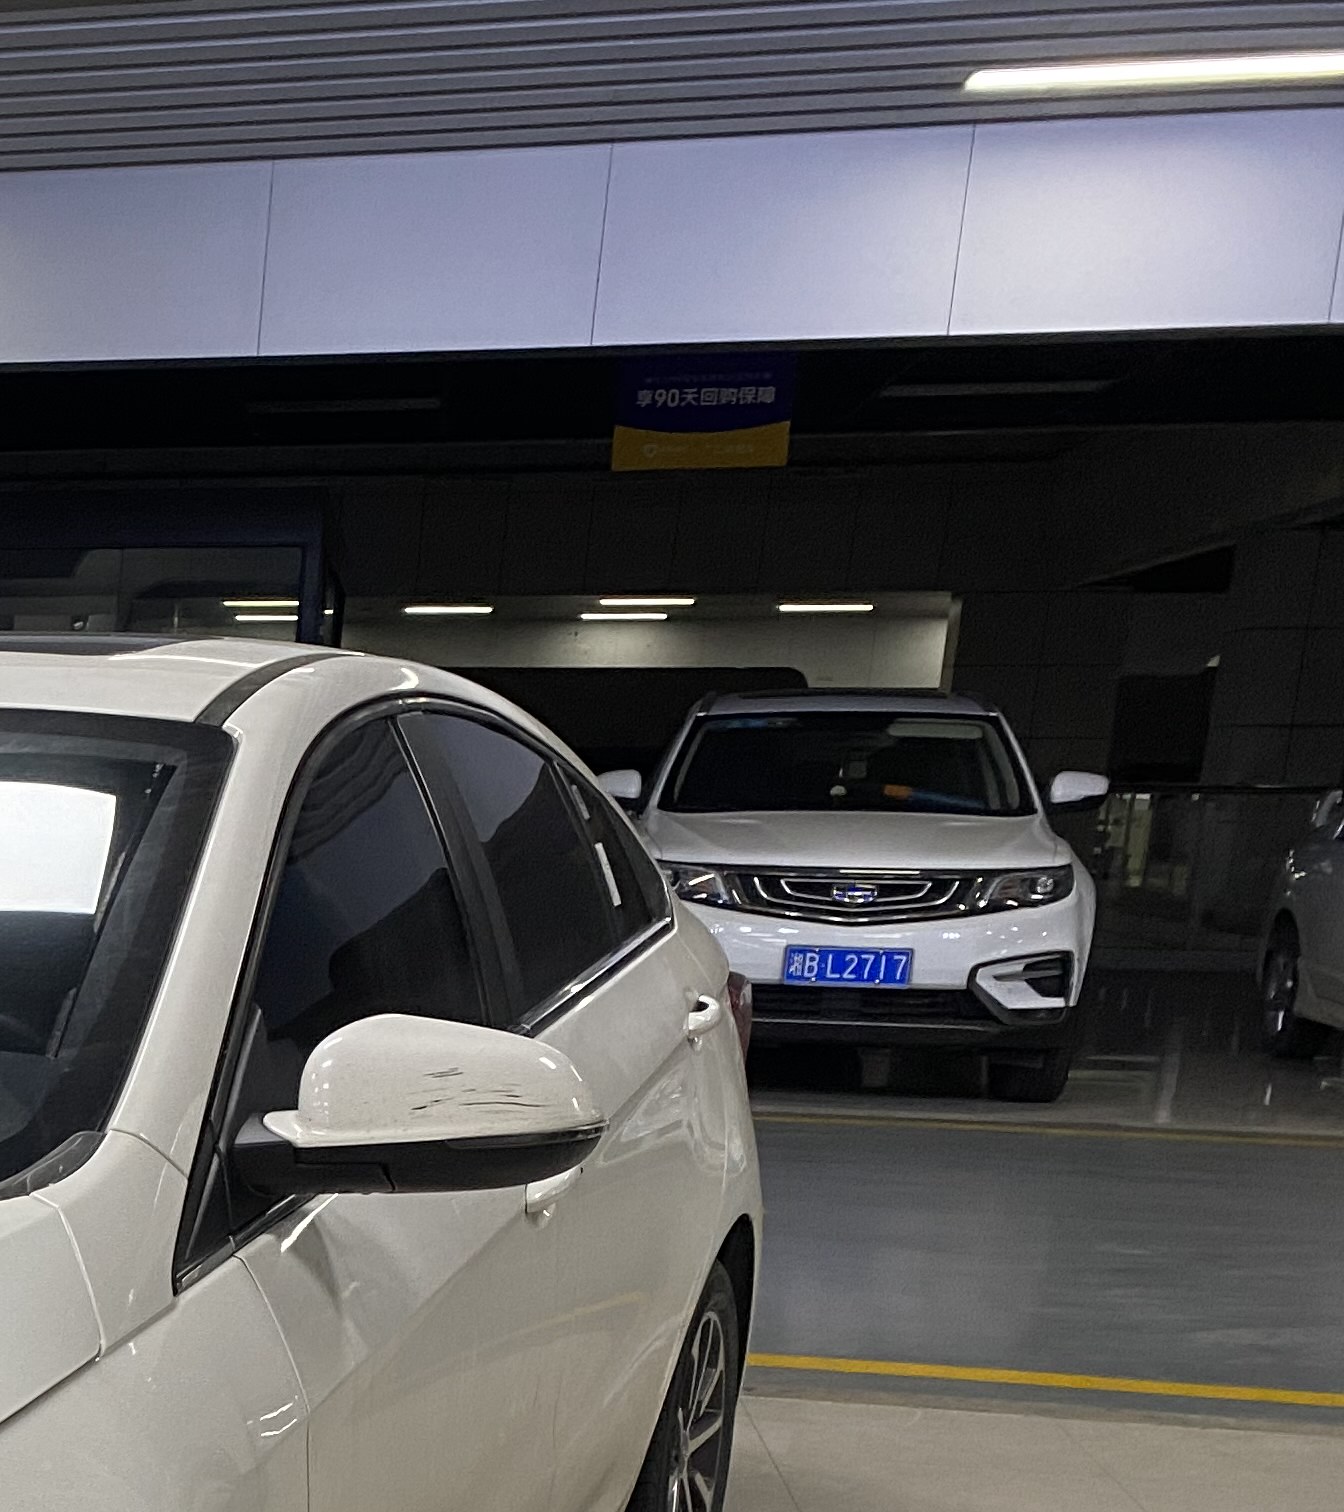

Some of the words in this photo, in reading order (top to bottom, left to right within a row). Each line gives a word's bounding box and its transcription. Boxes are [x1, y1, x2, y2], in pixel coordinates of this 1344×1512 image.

[635, 386, 777, 408] 享90天回购保障
